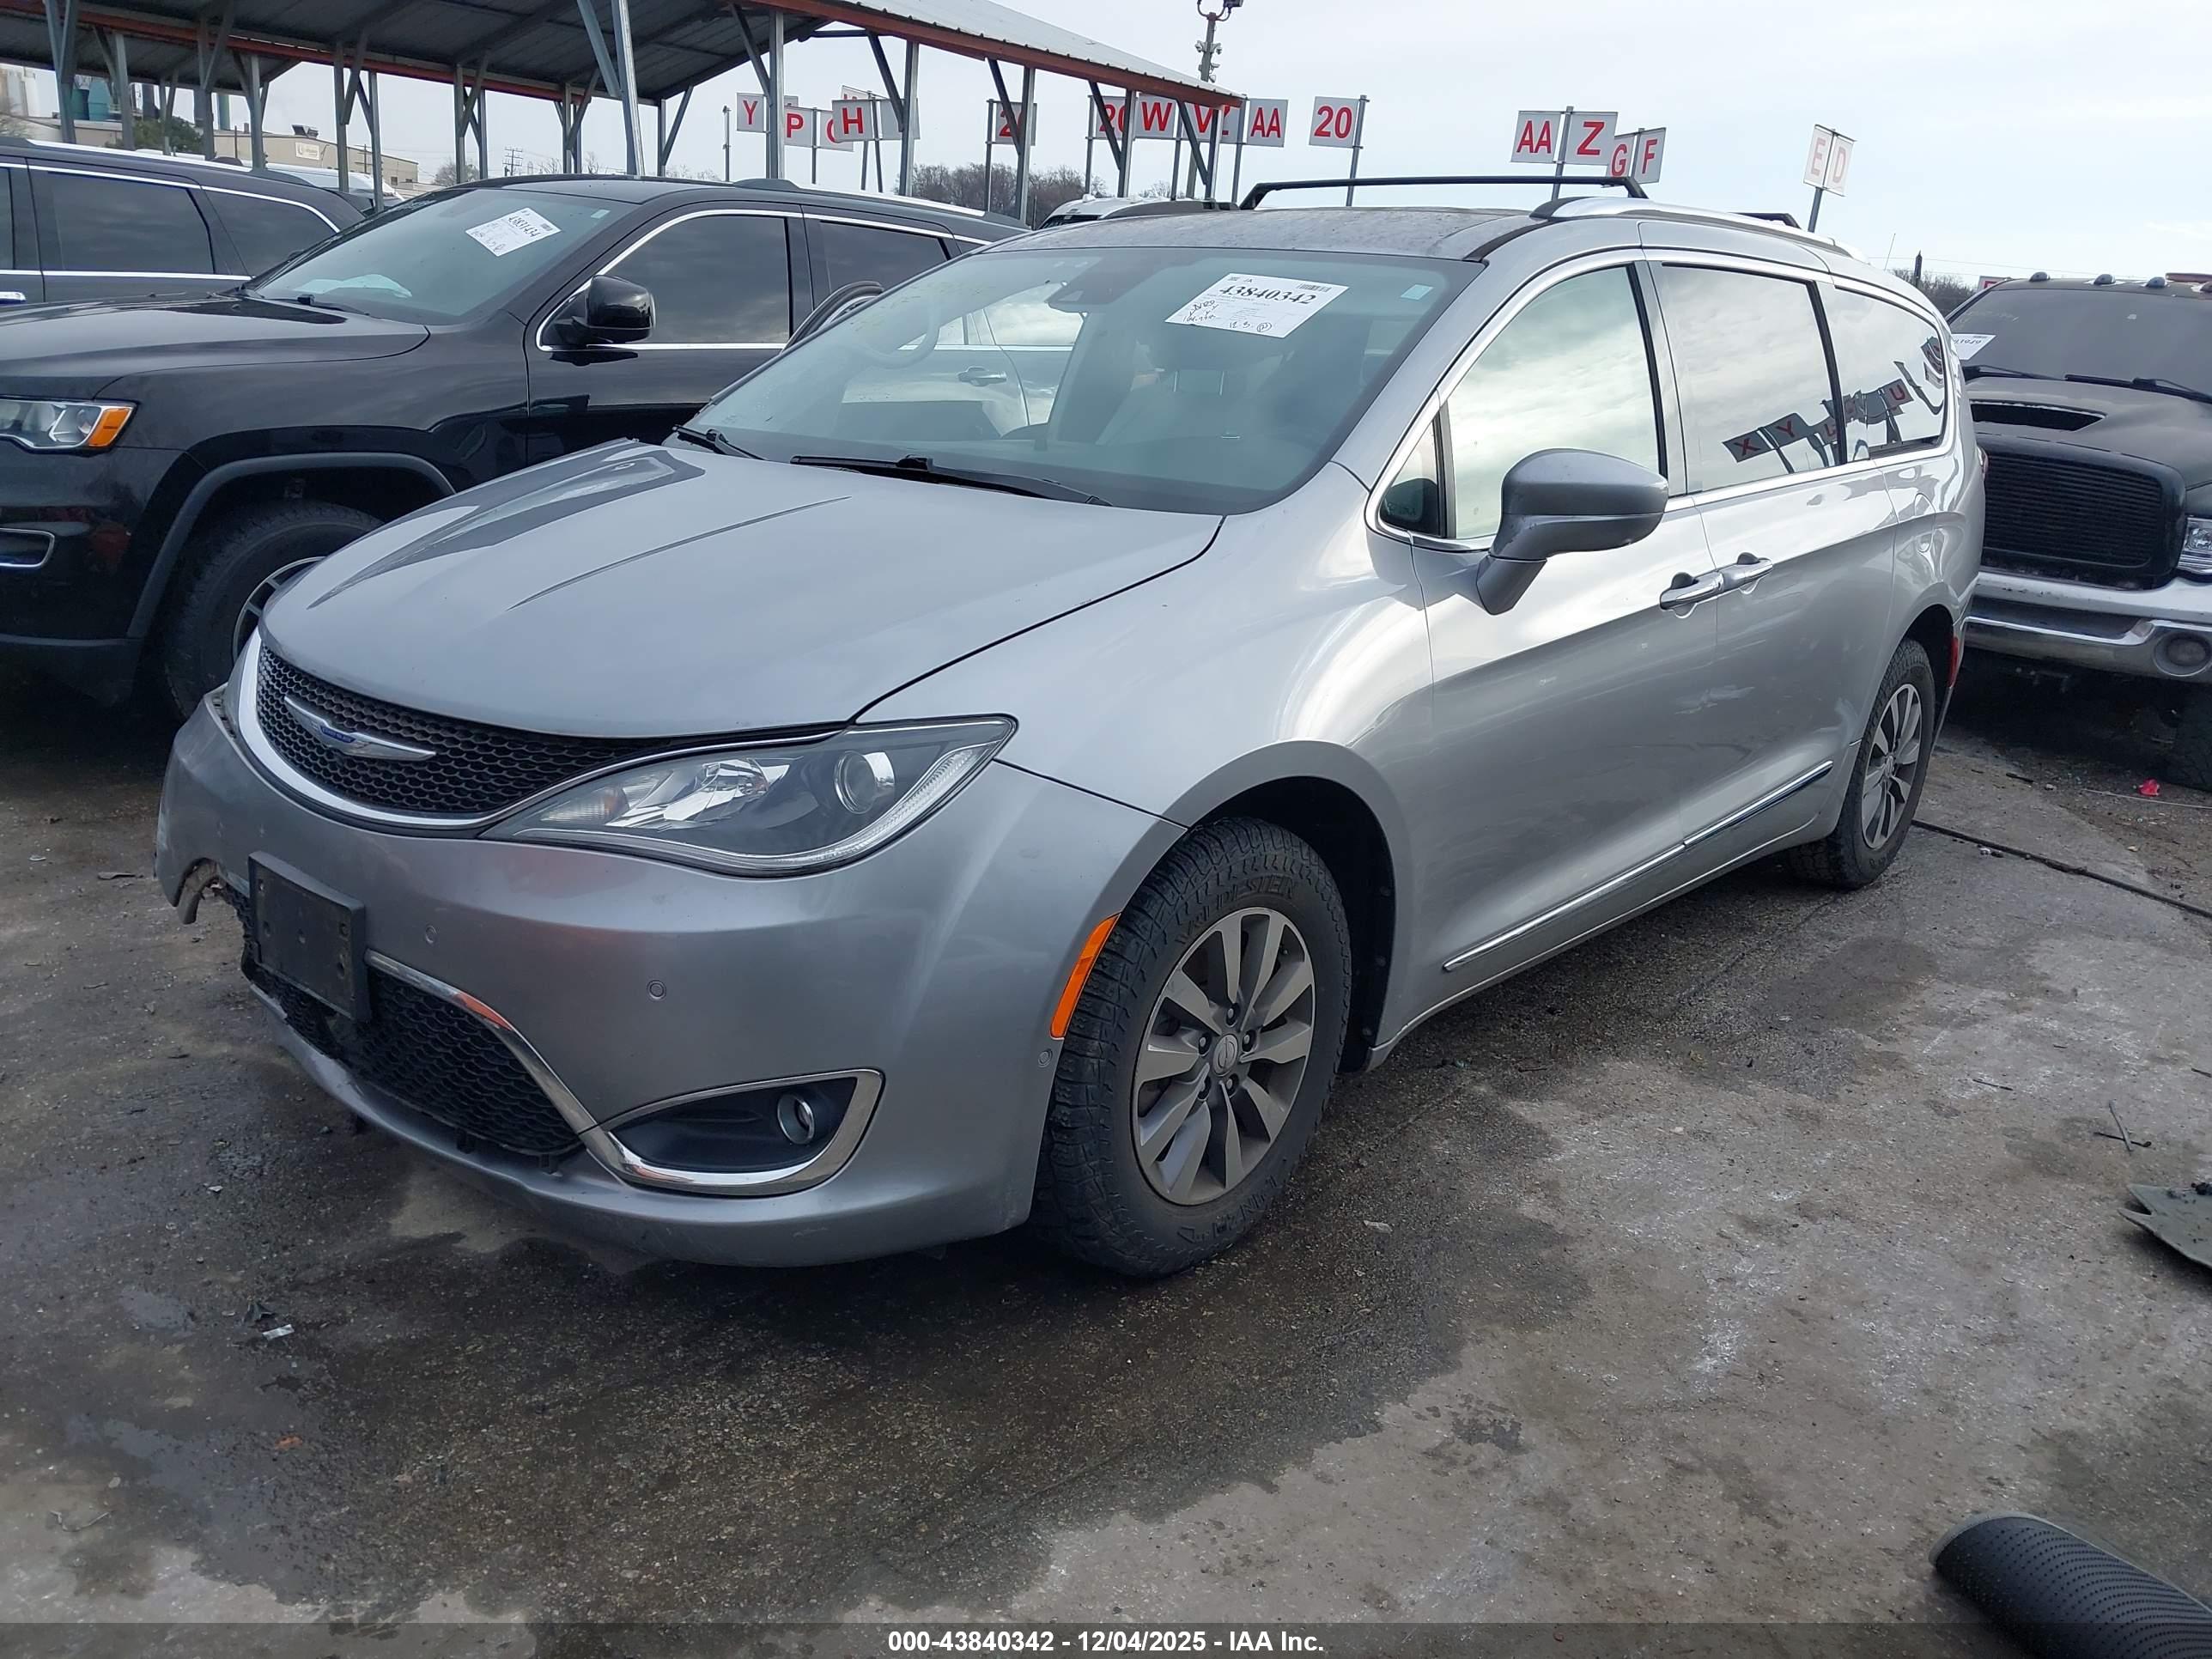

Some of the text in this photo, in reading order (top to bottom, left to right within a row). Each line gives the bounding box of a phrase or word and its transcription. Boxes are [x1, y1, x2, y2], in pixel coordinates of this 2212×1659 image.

[743, 100, 758, 125] Y
[786, 112, 805, 138] P
[842, 106, 864, 135] H
[1141, 101, 1173, 131] W
[1250, 106, 1282, 138] AA
[1314, 106, 1353, 138] 20
[1516, 119, 1606, 156] AA Z
[1611, 138, 1658, 177] G F
[1809, 137, 1826, 177] E
[1219, 285, 1317, 305] 43840342
